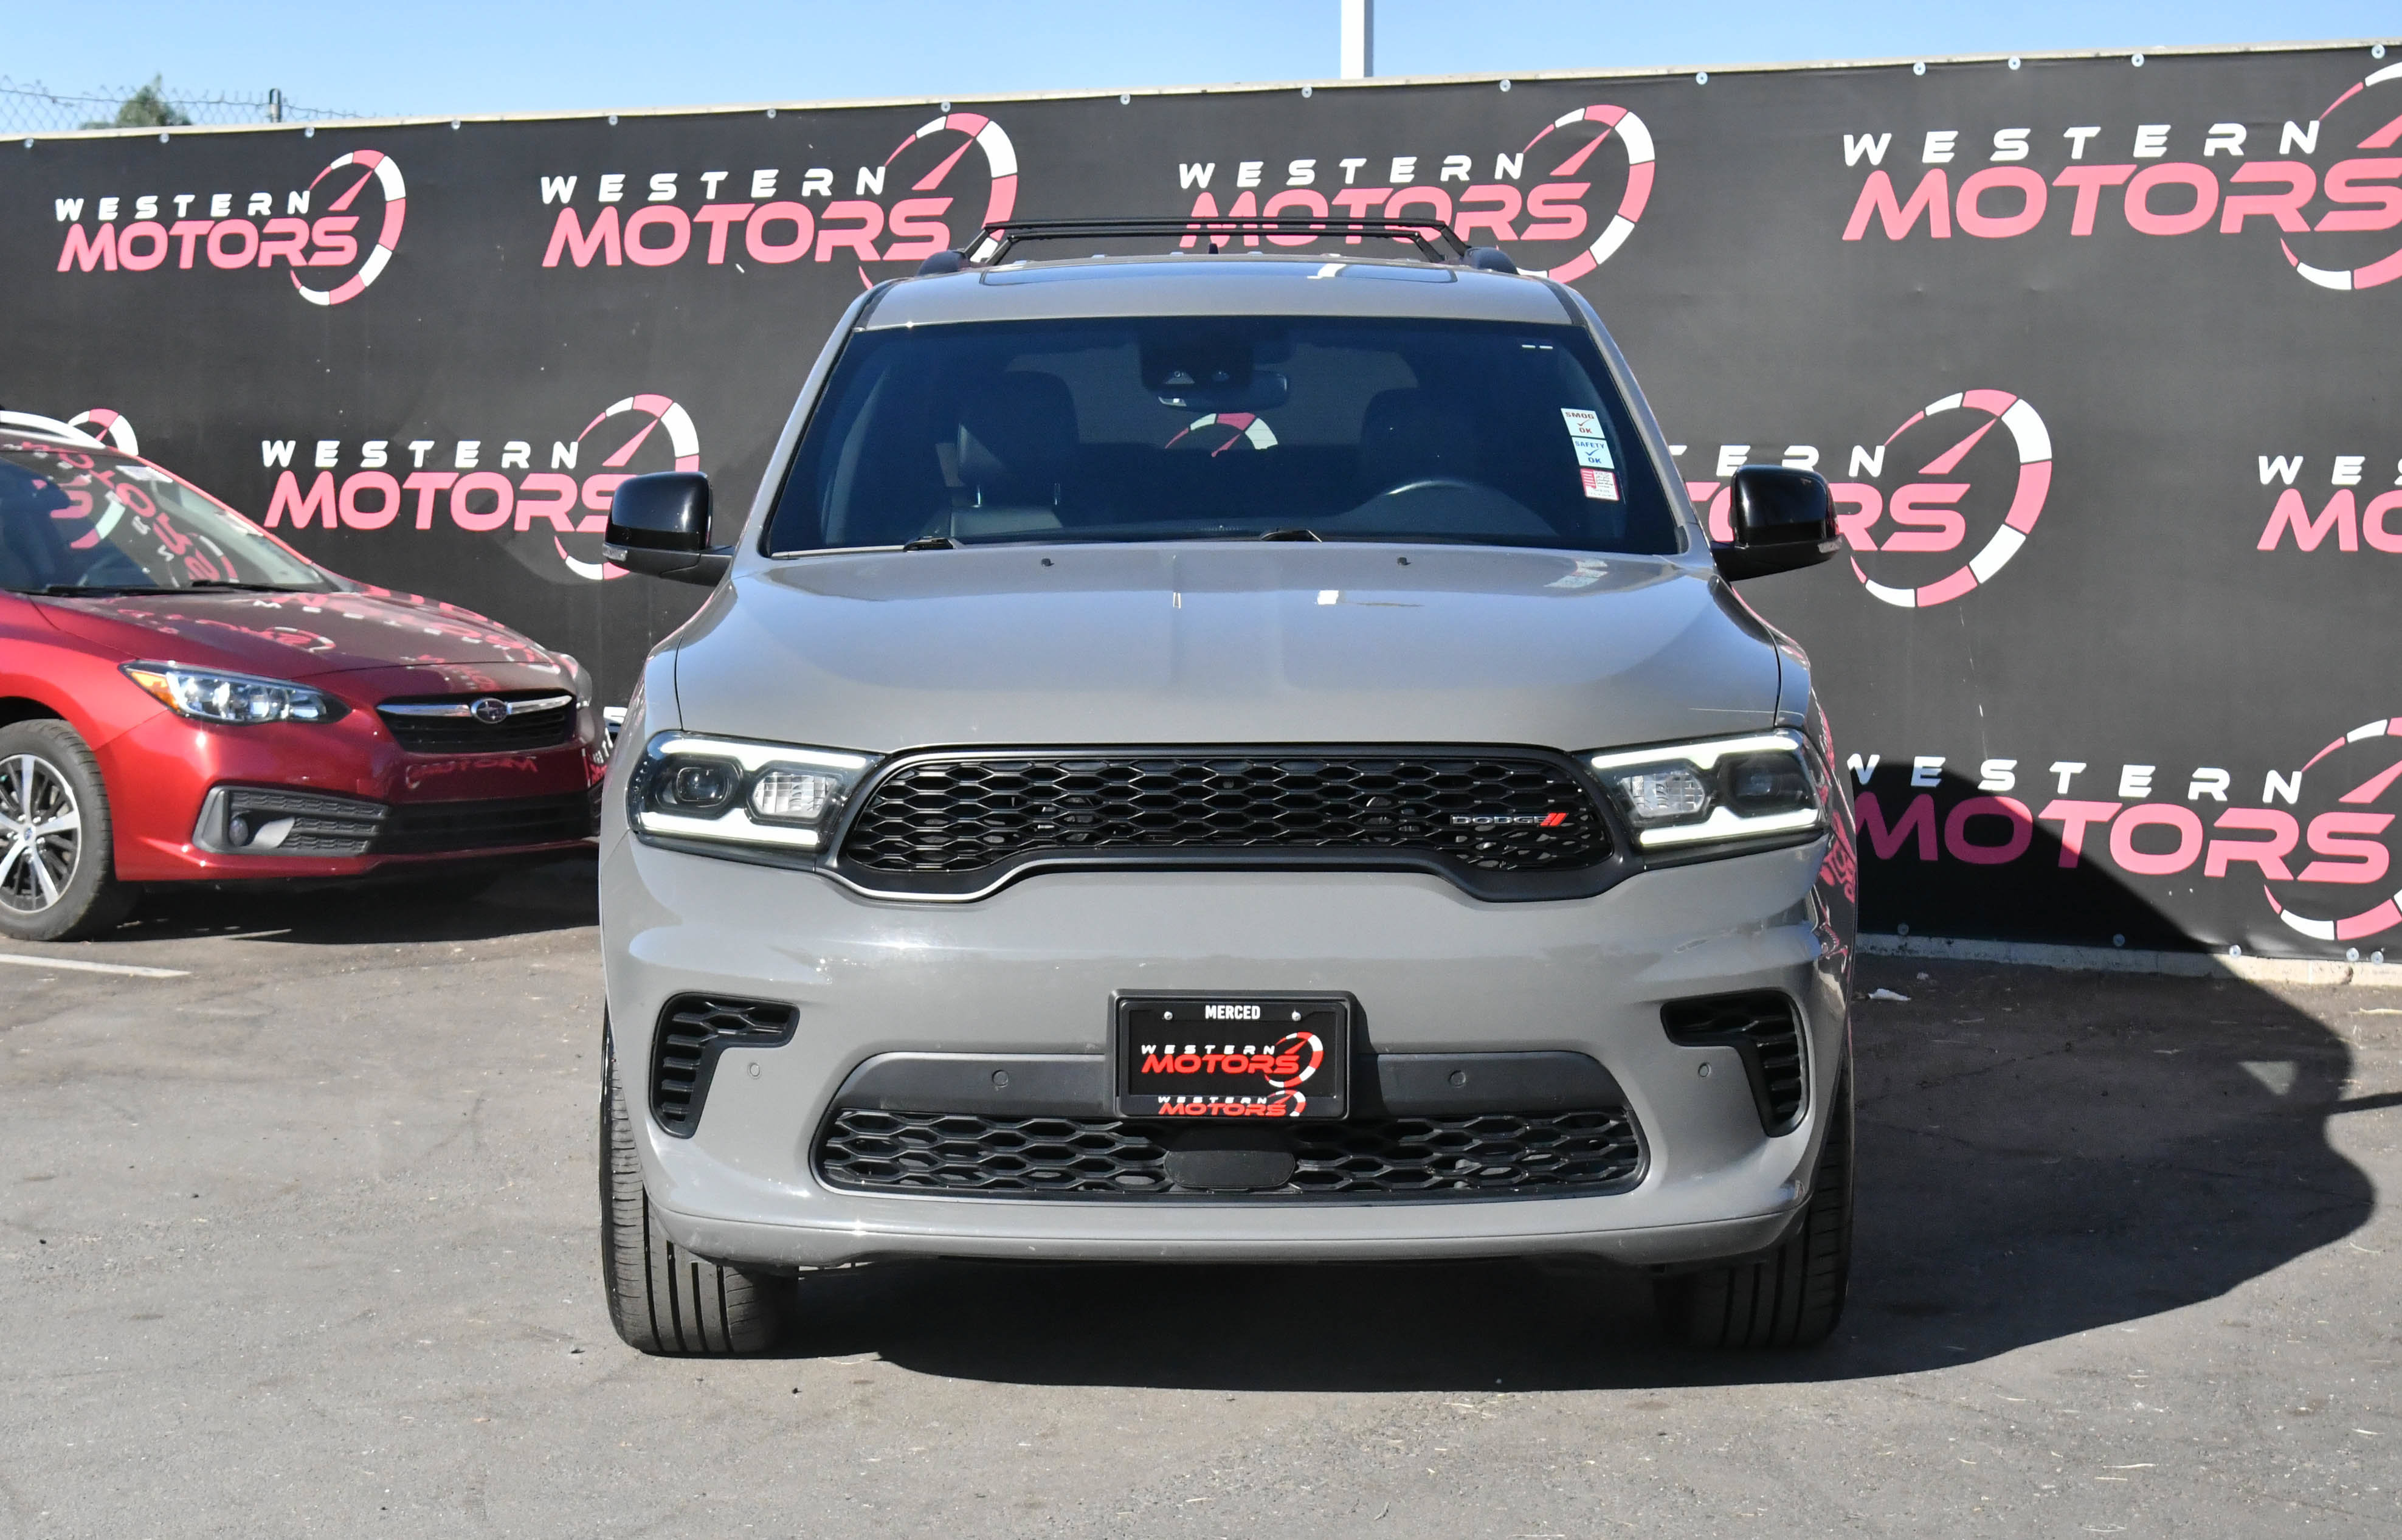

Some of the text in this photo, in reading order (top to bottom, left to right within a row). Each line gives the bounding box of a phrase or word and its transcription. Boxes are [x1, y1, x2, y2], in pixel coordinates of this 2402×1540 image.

[1843, 120, 2319, 167] WESTERN
[541, 167, 886, 204] WESTERN
[1179, 153, 1524, 189] WESTERN
[55, 190, 311, 221] WESTERN
[1179, 182, 1590, 248] MOTORS
[1842, 157, 2402, 241] MOTORS
[57, 215, 360, 272] MOTORS
[542, 196, 953, 268] MOTORS
[262, 438, 579, 469] WESTERN
[2259, 455, 2402, 485] WE
[263, 470, 637, 534] MOTORS
[1451, 815, 1551, 825] DODGE
[1855, 791, 2396, 885] MOTORS
[1206, 1005, 1261, 1020] MERCED
[1141, 1045, 1275, 1055] WESTERN
[1141, 1054, 1300, 1074] MOTORS
[1158, 1102, 1286, 1117] MOTORS
